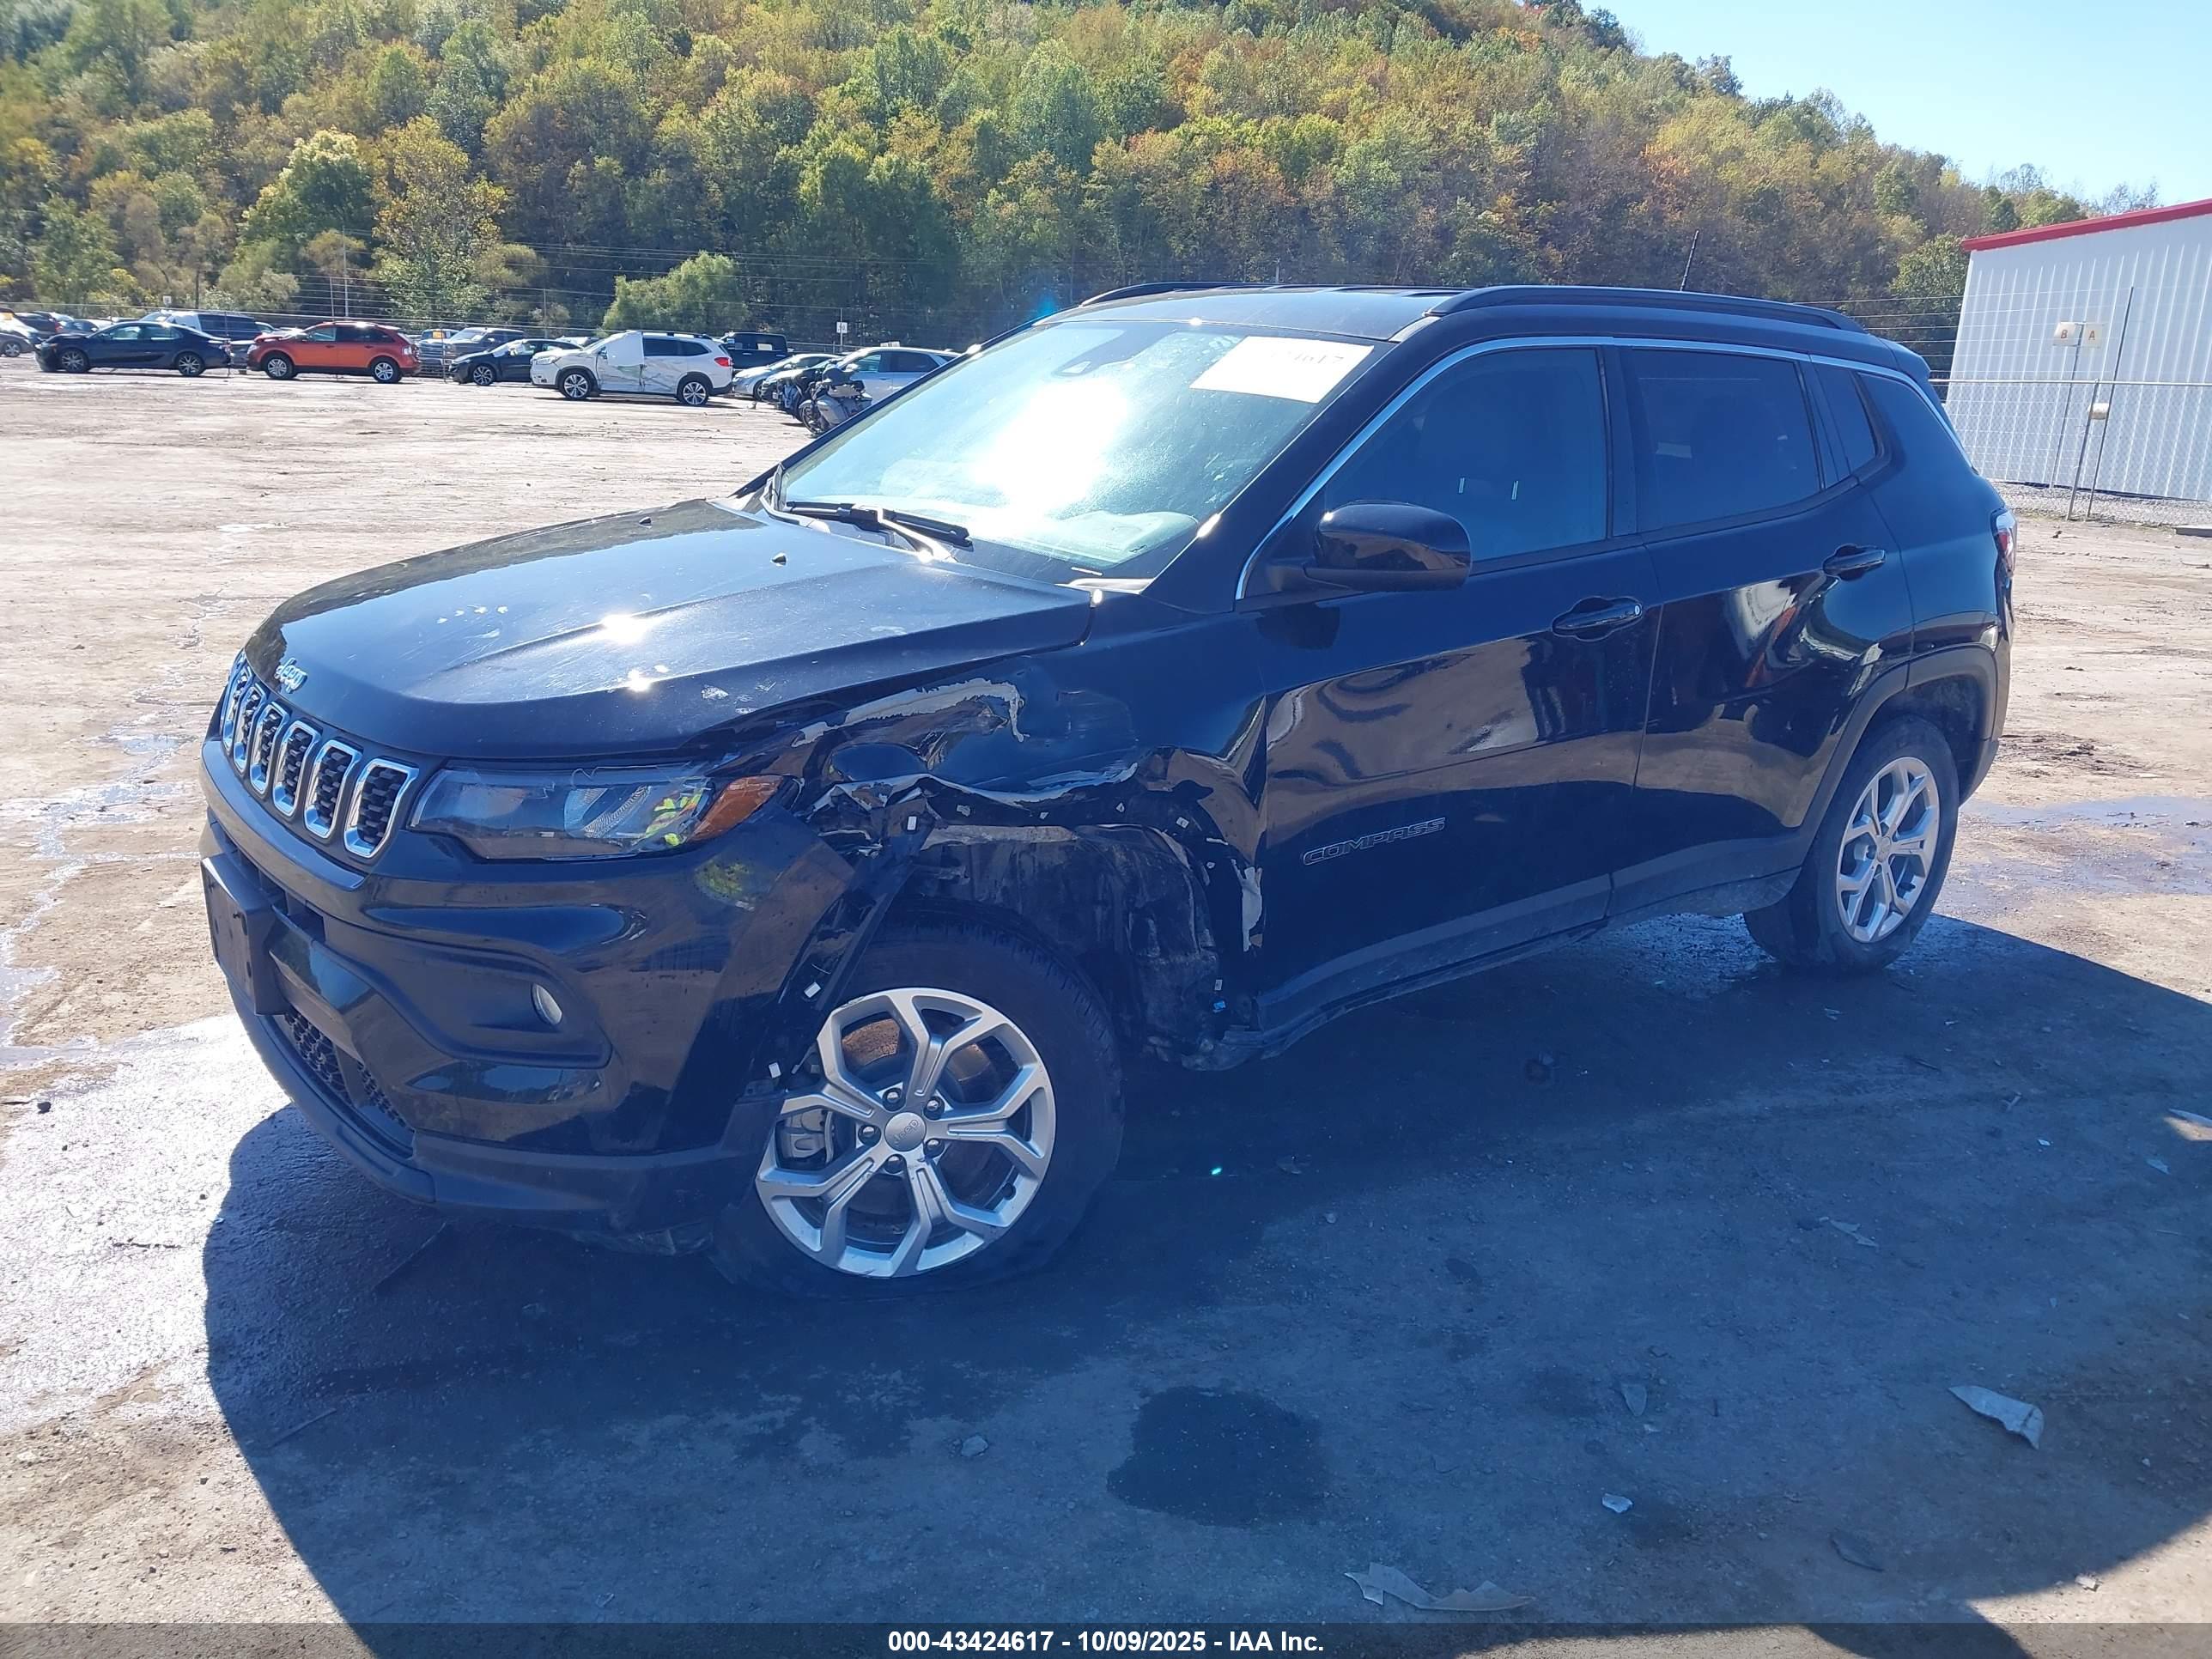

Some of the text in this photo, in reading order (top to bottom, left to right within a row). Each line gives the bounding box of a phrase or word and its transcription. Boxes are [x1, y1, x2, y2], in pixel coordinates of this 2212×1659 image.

[2060, 329, 2068, 339] B
[2087, 330, 2095, 340] A
[273, 656, 308, 694] Jeep
[1302, 817, 1446, 866] COMPASS
[893, 1118, 919, 1146] Jeep
